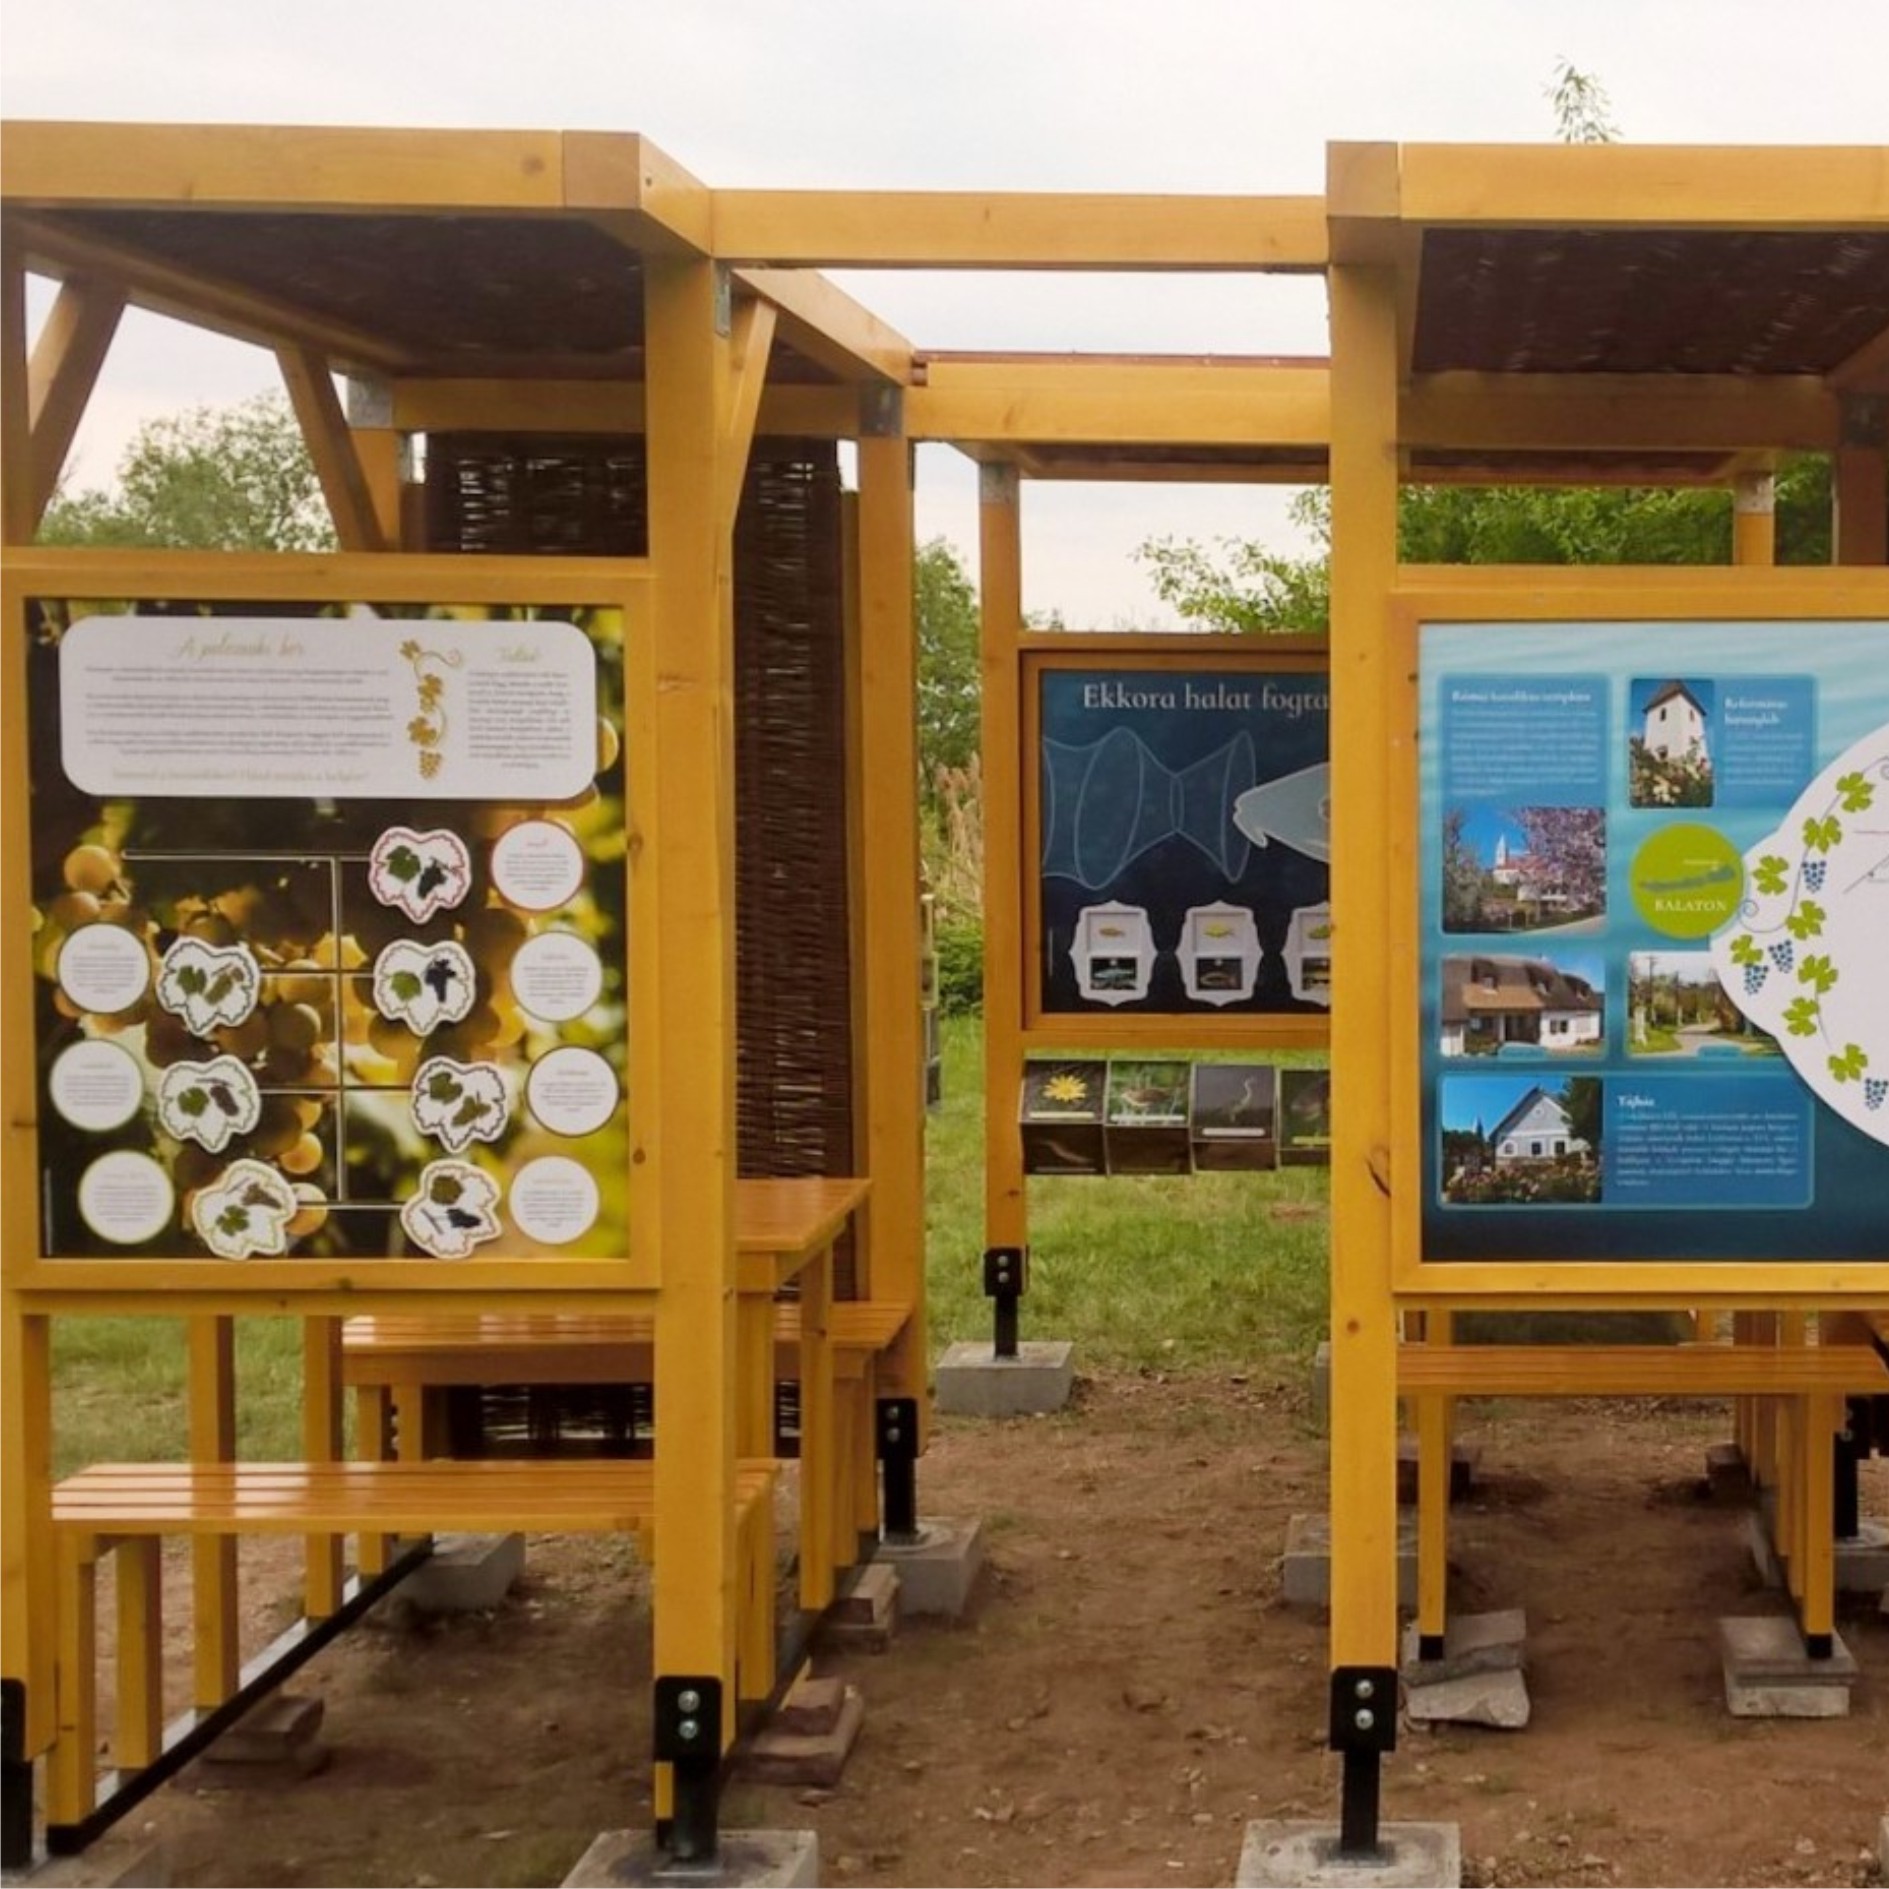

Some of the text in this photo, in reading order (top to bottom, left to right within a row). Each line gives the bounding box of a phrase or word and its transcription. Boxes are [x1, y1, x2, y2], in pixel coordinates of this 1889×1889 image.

[1083, 683, 1175, 709] Ekkora
[1185, 683, 1251, 710] halat
[1654, 899, 1727, 912] BALATON
